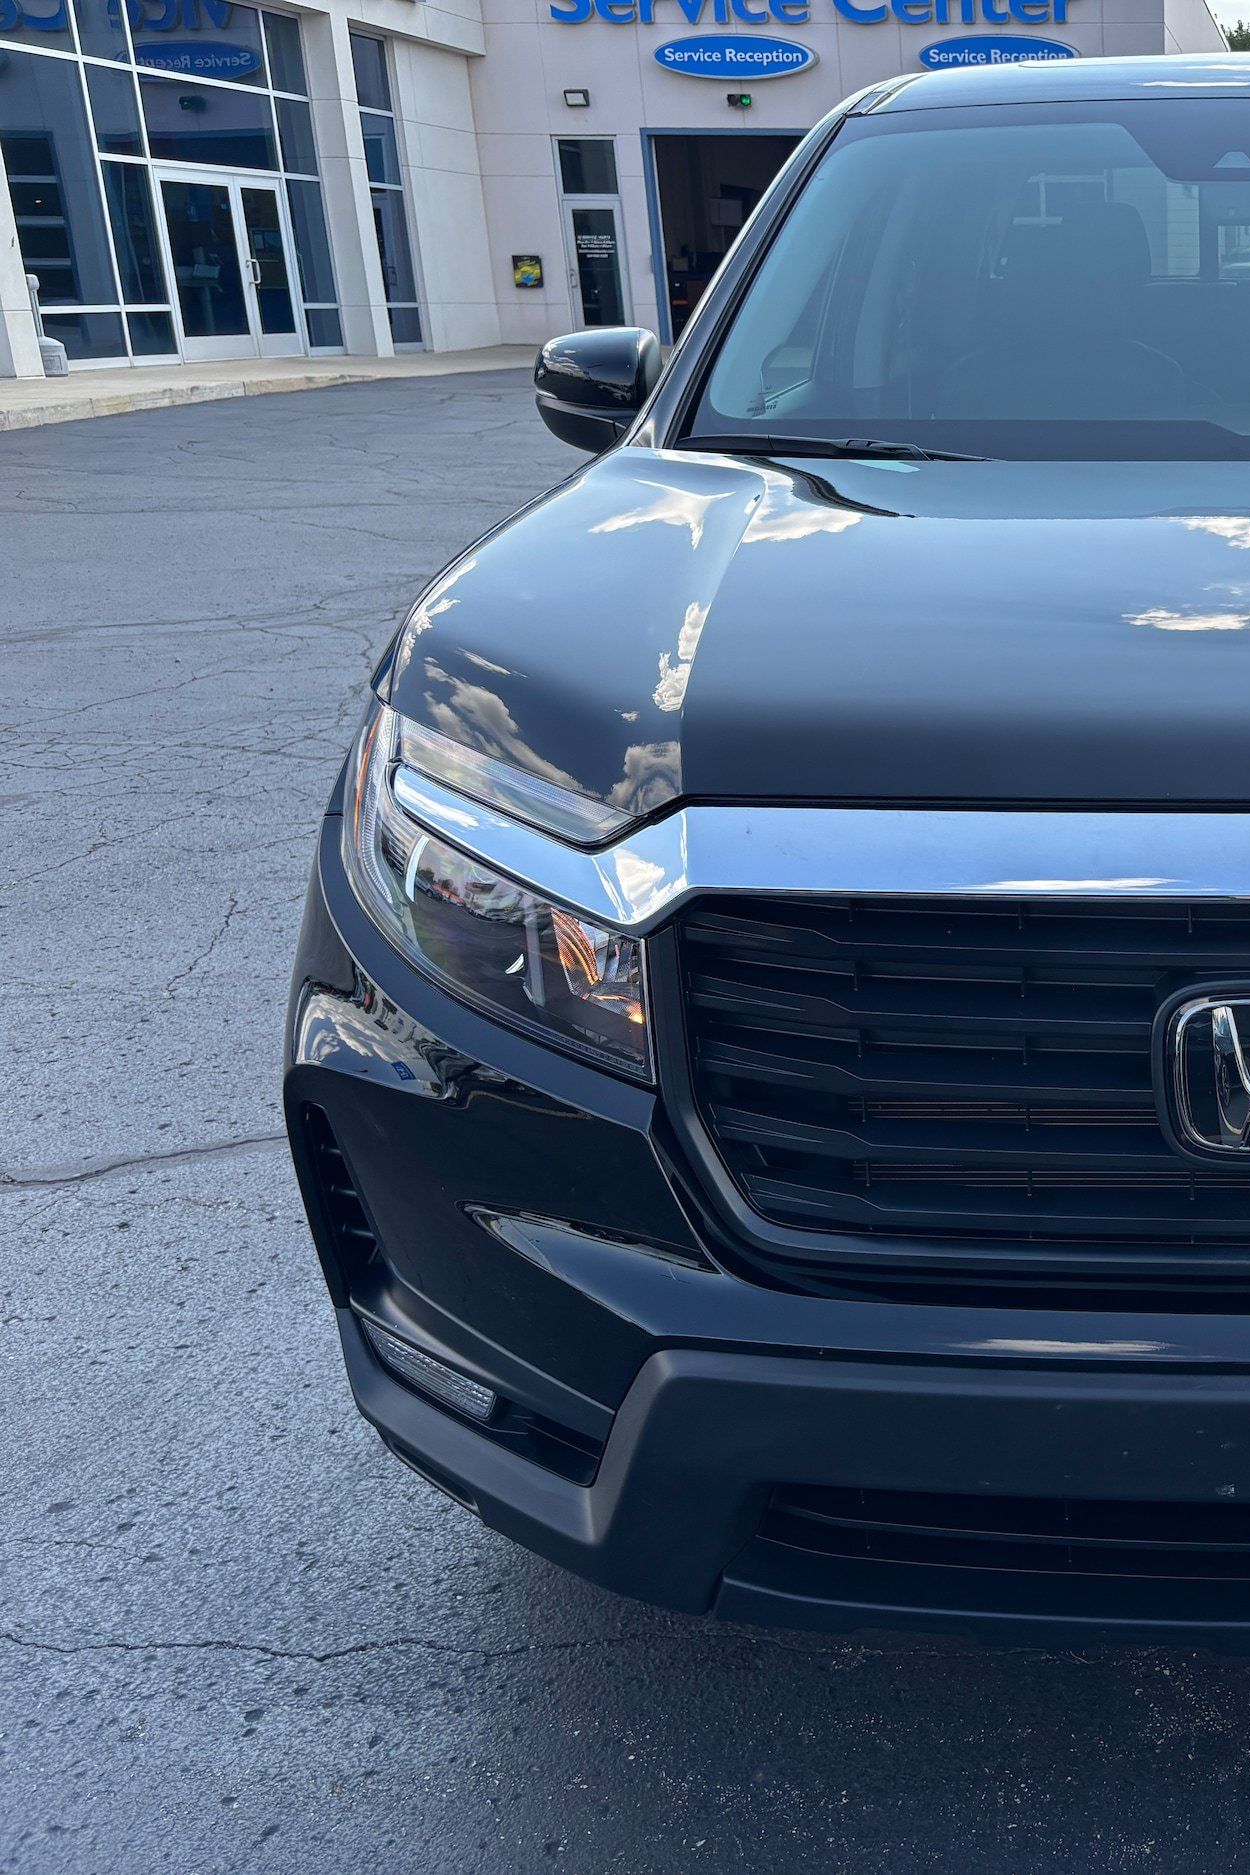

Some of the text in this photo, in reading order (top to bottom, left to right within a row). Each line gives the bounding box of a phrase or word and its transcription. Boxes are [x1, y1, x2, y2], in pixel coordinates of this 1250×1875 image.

[664, 48, 802, 66] Service Reception
[929, 49, 987, 63] Service
